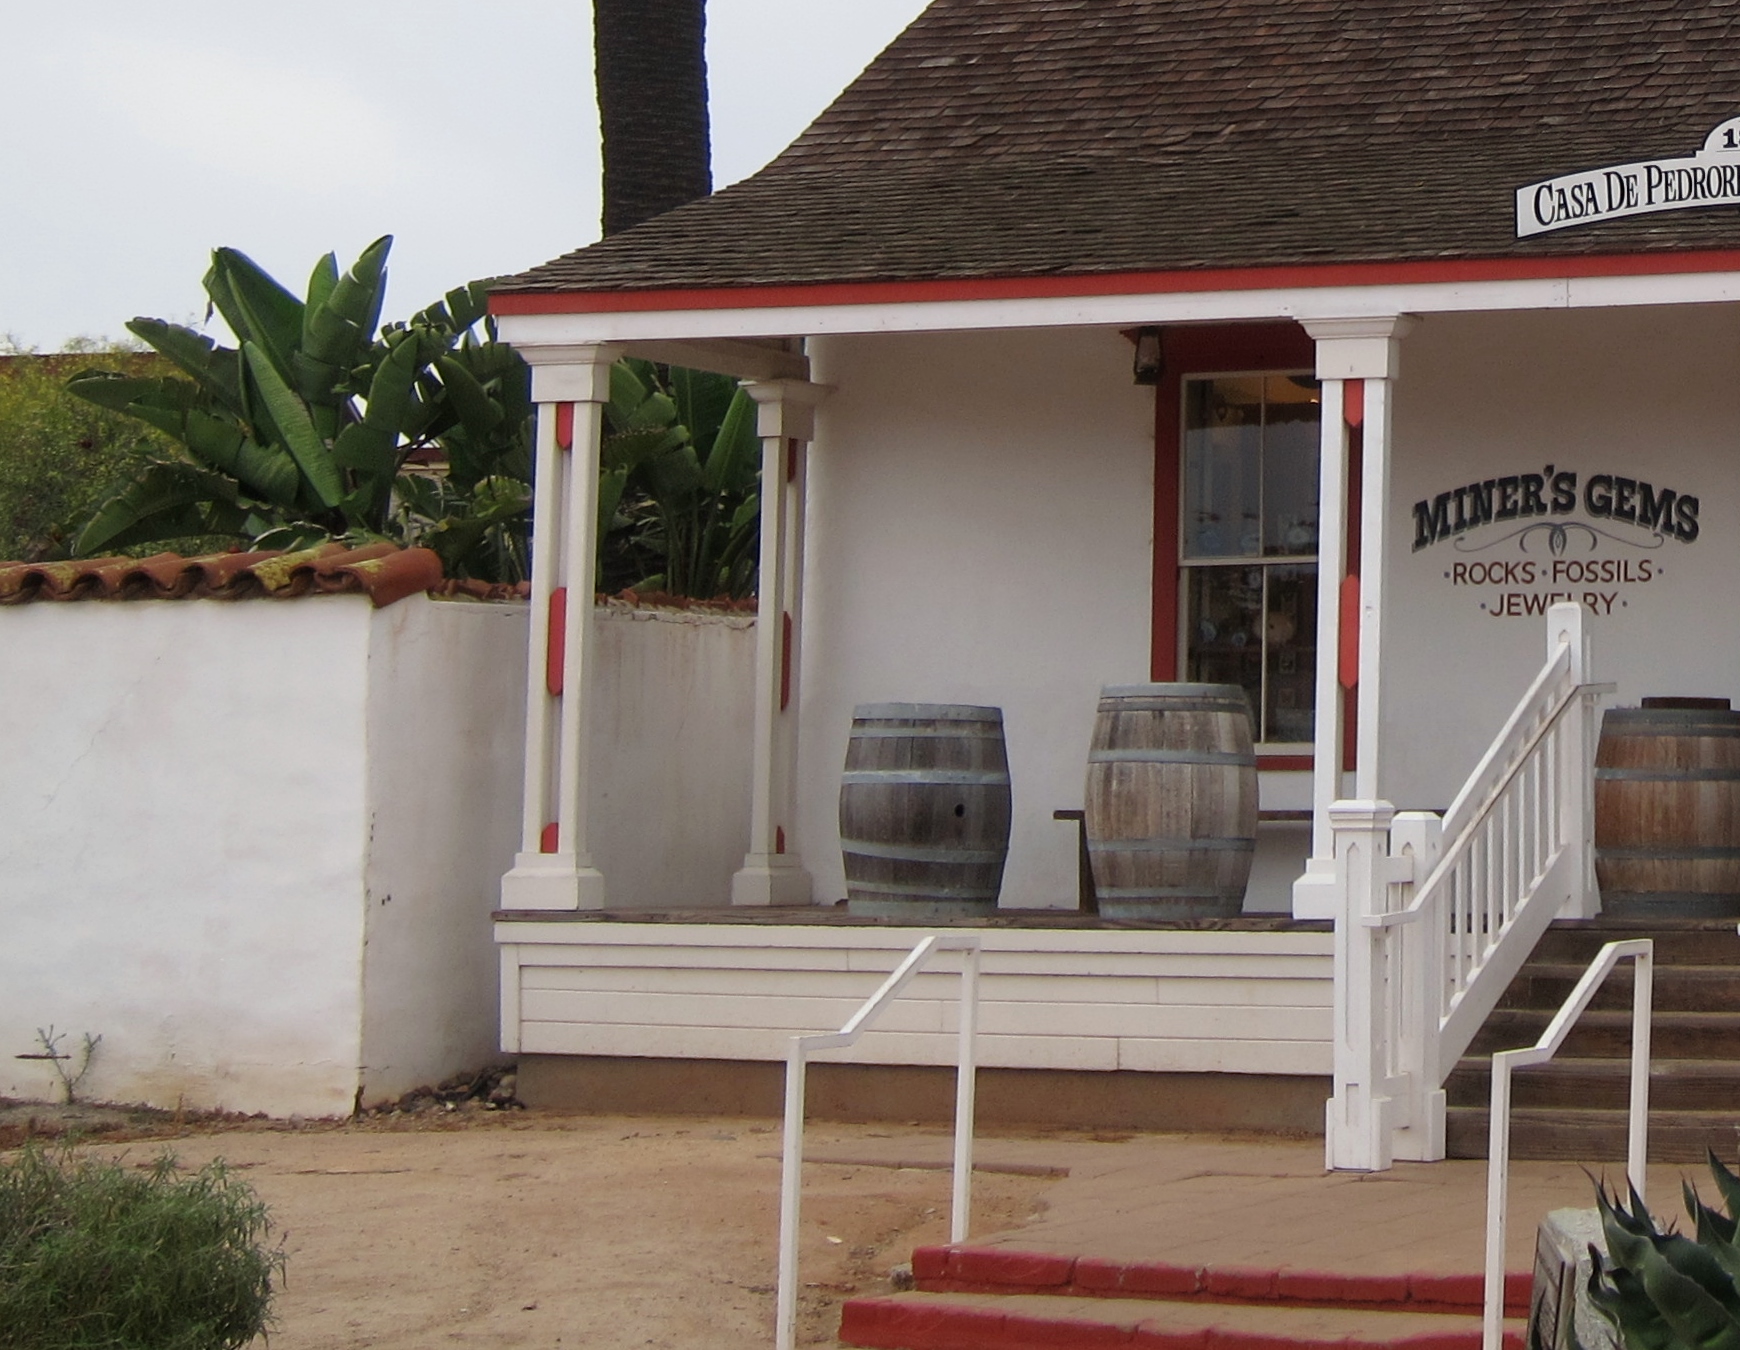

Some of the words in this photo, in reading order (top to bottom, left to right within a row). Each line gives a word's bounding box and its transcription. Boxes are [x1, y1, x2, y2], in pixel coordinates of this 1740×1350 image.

[1534, 181, 1601, 226] CASA
[1603, 171, 1639, 212] DE
[1411, 464, 1577, 553] MINER'S
[1583, 473, 1699, 544] GEMS
[1453, 561, 1536, 585] ROCKS
[1552, 560, 1653, 583] FOSSILS
